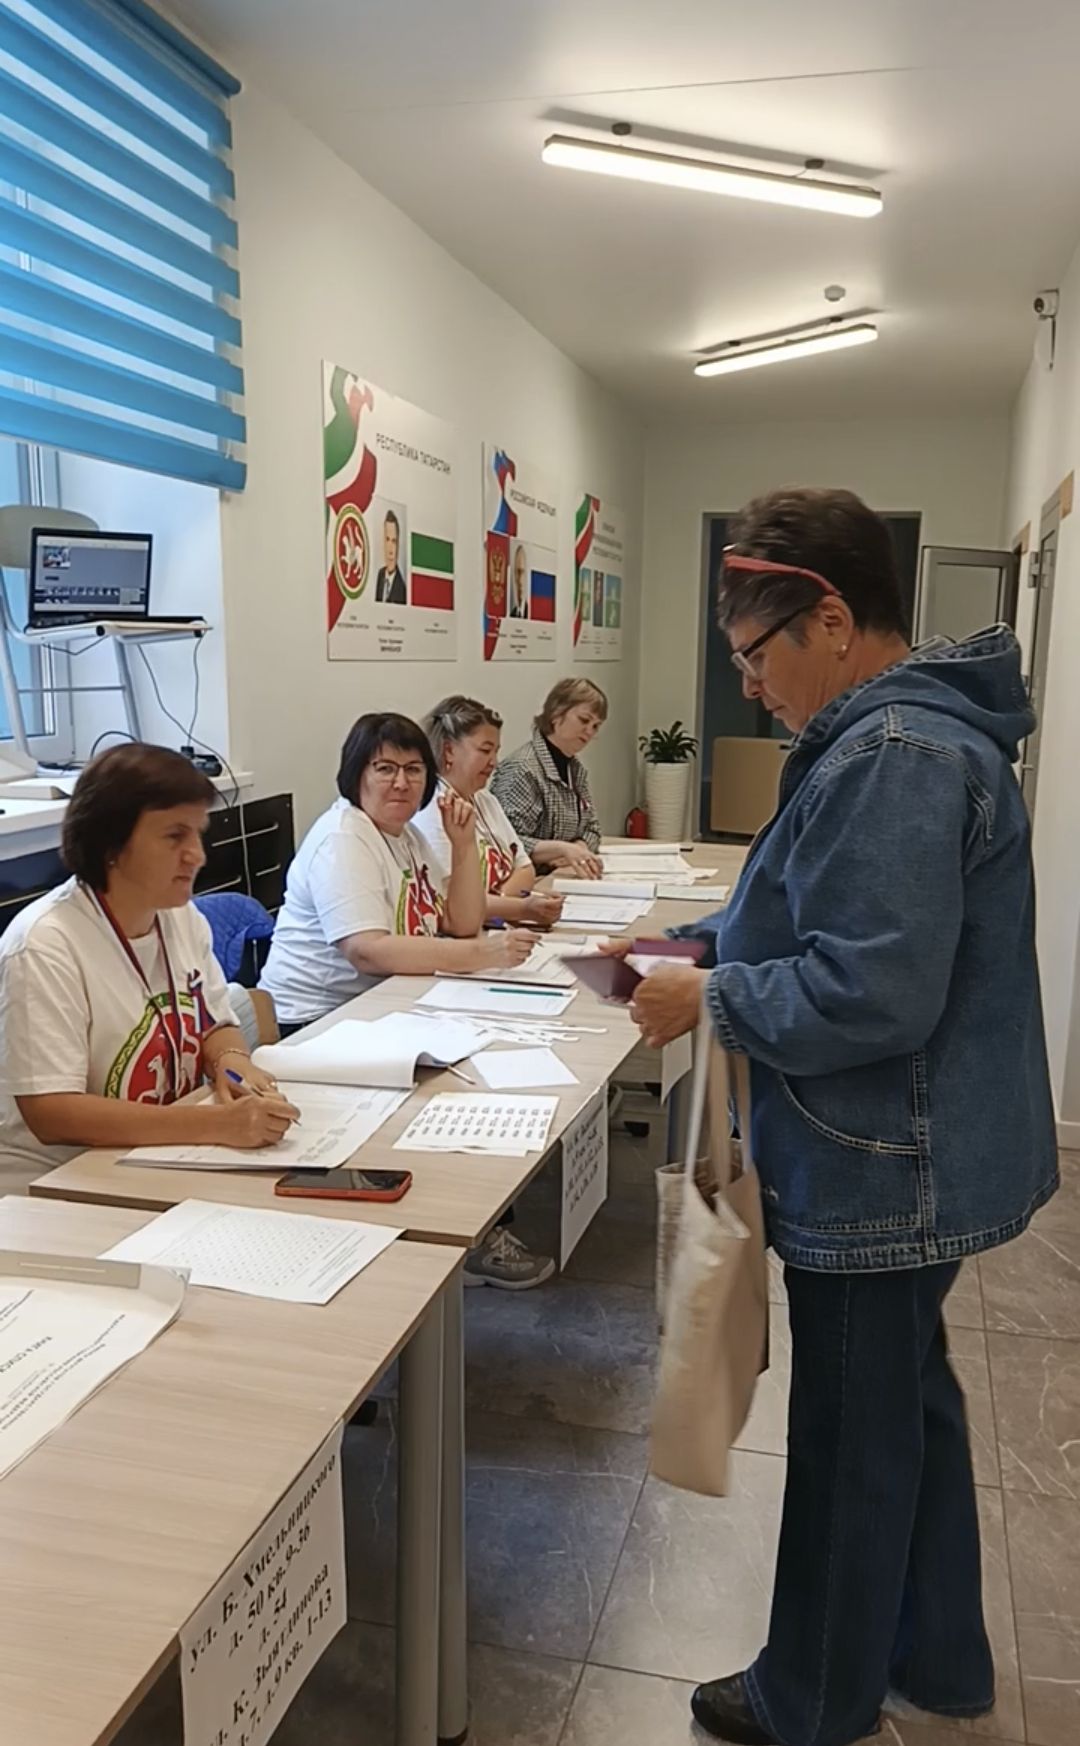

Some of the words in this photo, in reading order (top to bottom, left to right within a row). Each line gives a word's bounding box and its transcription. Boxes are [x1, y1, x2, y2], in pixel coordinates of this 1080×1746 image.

[190, 1626, 217, 1674] ул.
[222, 1591, 239, 1624] Б.
[243, 1454, 335, 1599] Хмельницкого
[228, 1631, 243, 1659] д.
[248, 1590, 264, 1629] 50
[259, 1627, 270, 1653] д.
[273, 1588, 287, 1625] 54
[285, 1641, 303, 1674] кв.
[308, 1588, 332, 1636] 1-13
[233, 1689, 249, 1725] К.
